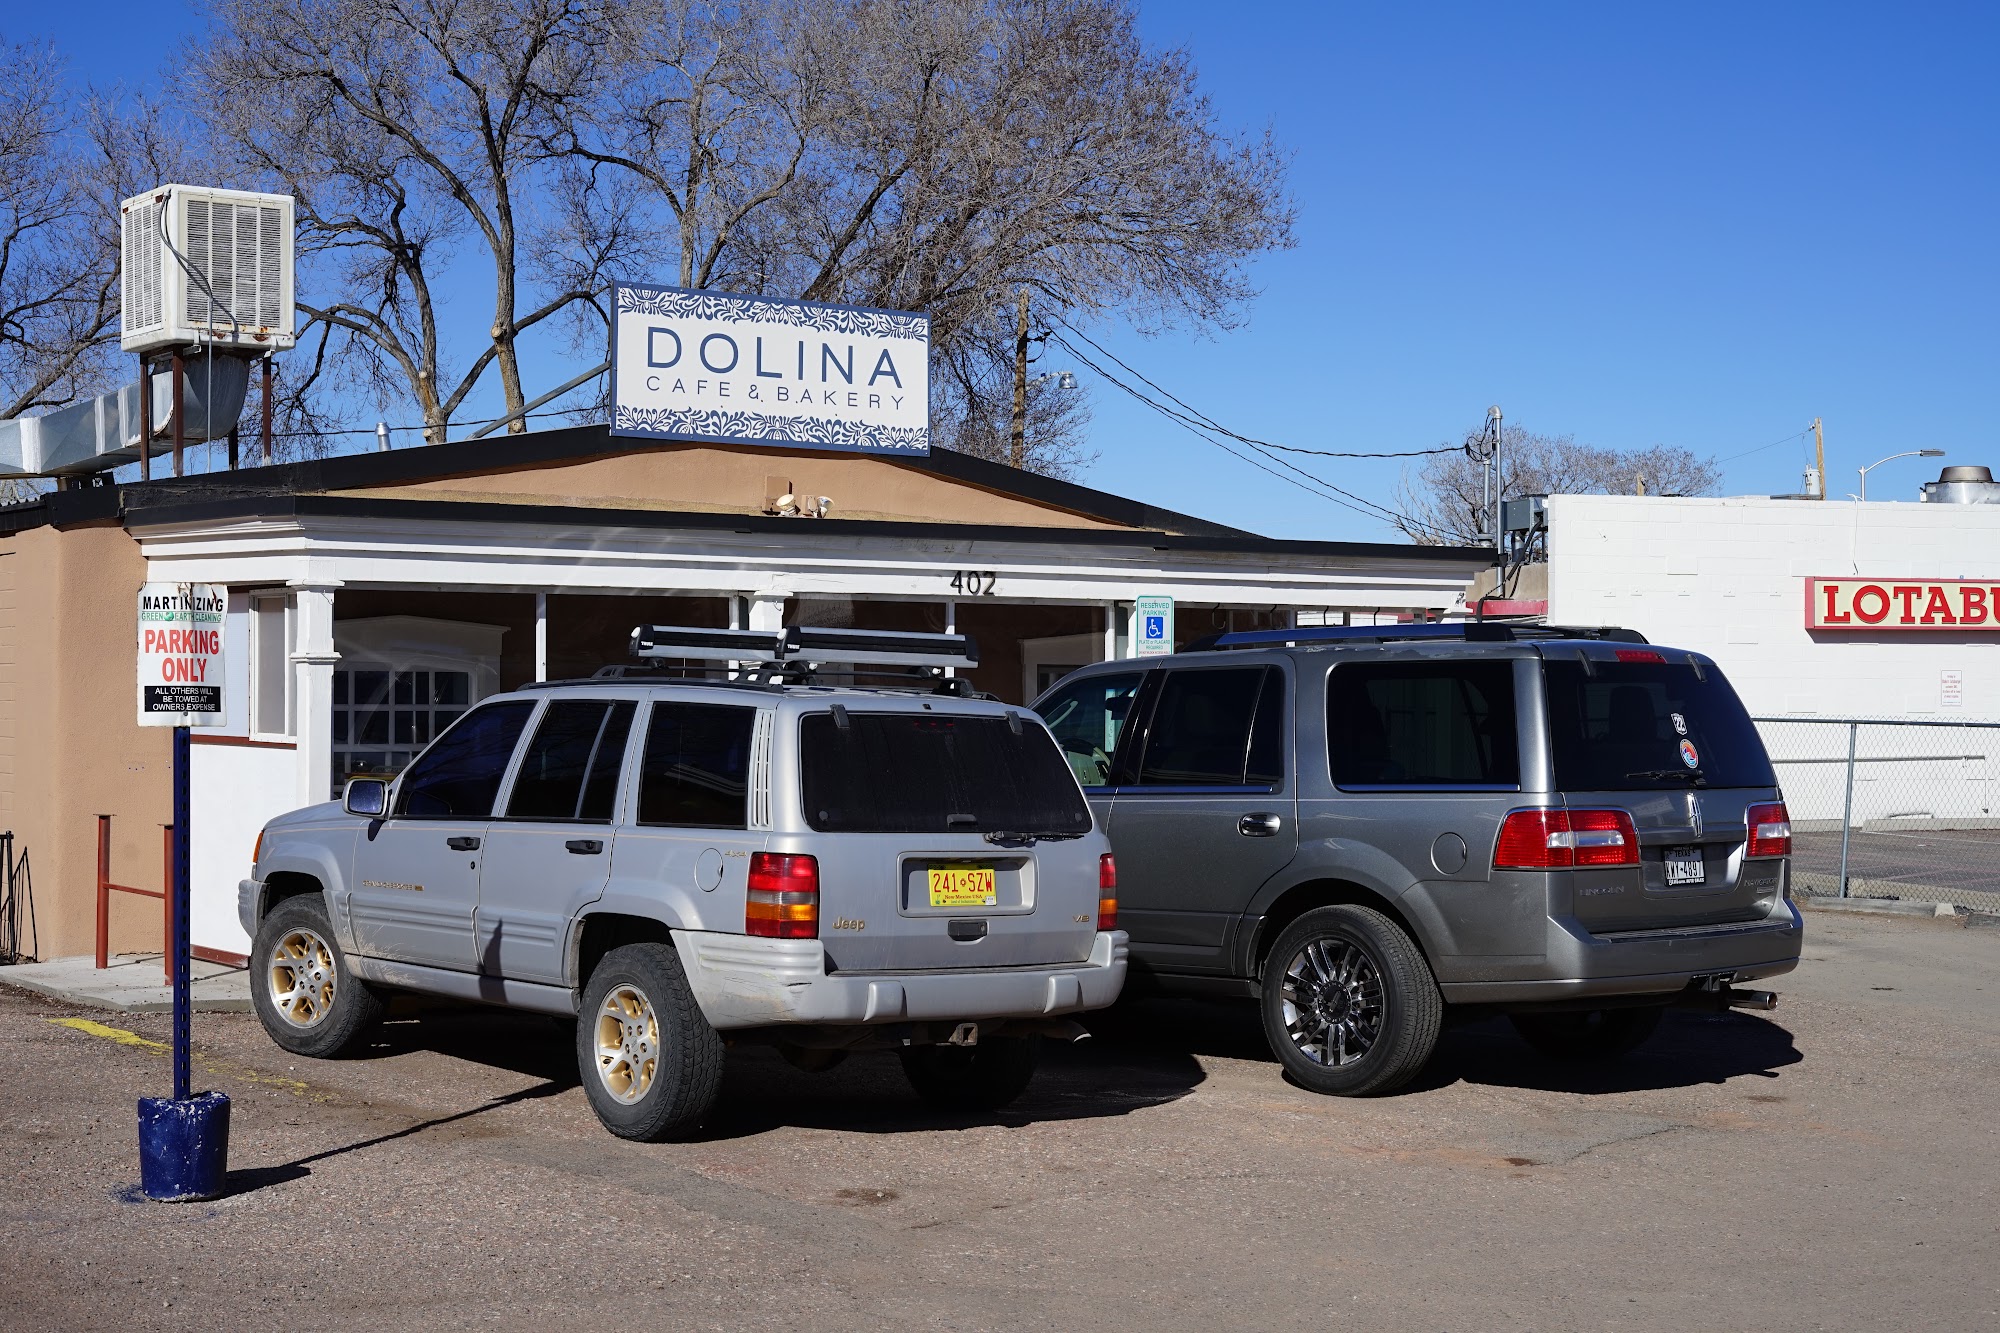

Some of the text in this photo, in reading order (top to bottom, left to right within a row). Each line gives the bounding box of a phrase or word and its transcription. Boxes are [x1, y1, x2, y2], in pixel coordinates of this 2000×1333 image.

[647, 326, 903, 389] DOLINA
[646, 375, 904, 411] CAFE & BAKERY
[950, 570, 996, 596] 402
[143, 595, 224, 612] MARTINIZING
[141, 612, 163, 621] GREEN
[195, 613, 222, 622] CLEANING
[144, 629, 220, 655] PARKING
[162, 657, 207, 682] ONLY
[154, 687, 213, 695] ALL OTHERS WILL
[162, 695, 173, 703] BE
[174, 695, 199, 703] TOWED
[152, 703, 215, 711] OWNERS EXPENSE
[933, 873, 992, 893] 241 SZW
[832, 916, 865, 932] Jeep
